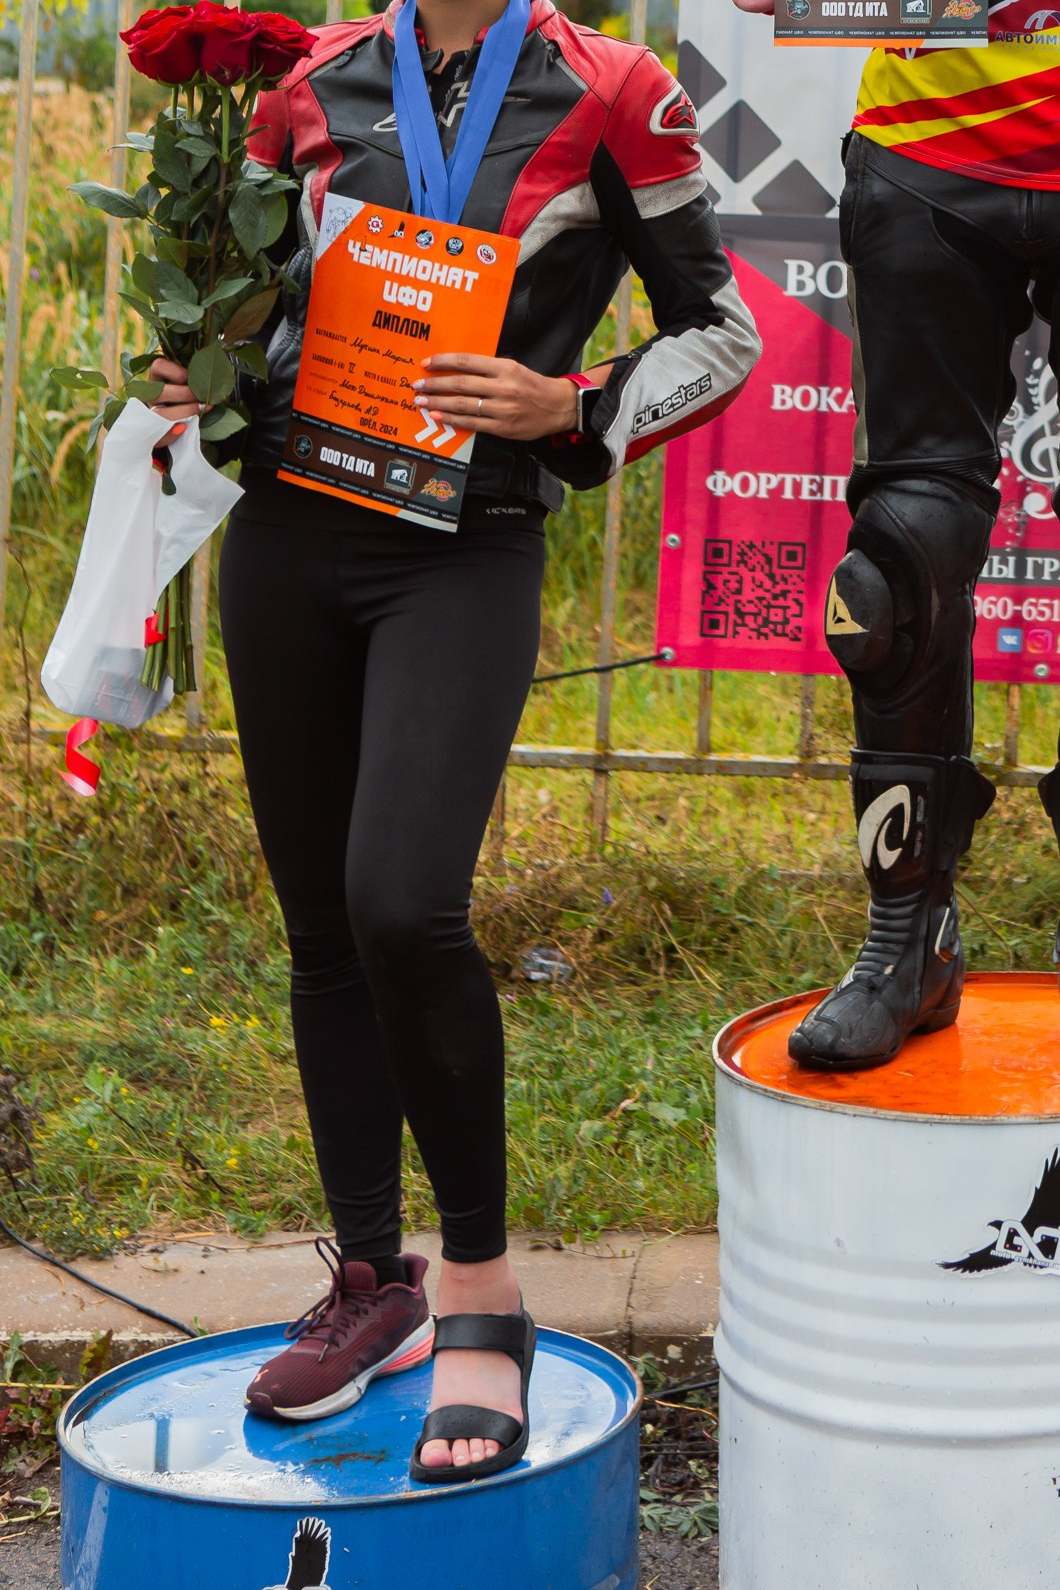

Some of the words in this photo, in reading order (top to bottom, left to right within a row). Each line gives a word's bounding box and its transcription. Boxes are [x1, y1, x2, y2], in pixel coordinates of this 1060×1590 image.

[821, 1, 846, 17] ООО
[847, 1, 864, 18] ТД
[865, 1, 888, 17] ИТА
[347, 238, 479, 293] ЧЕМПИОНАТ
[382, 280, 434, 312] ЦФО
[371, 310, 431, 342] ДИПЛОМ
[378, 422, 398, 437] 2024
[319, 446, 342, 466] ООО
[341, 452, 356, 472] ТД
[355, 457, 375, 478] ИТА
